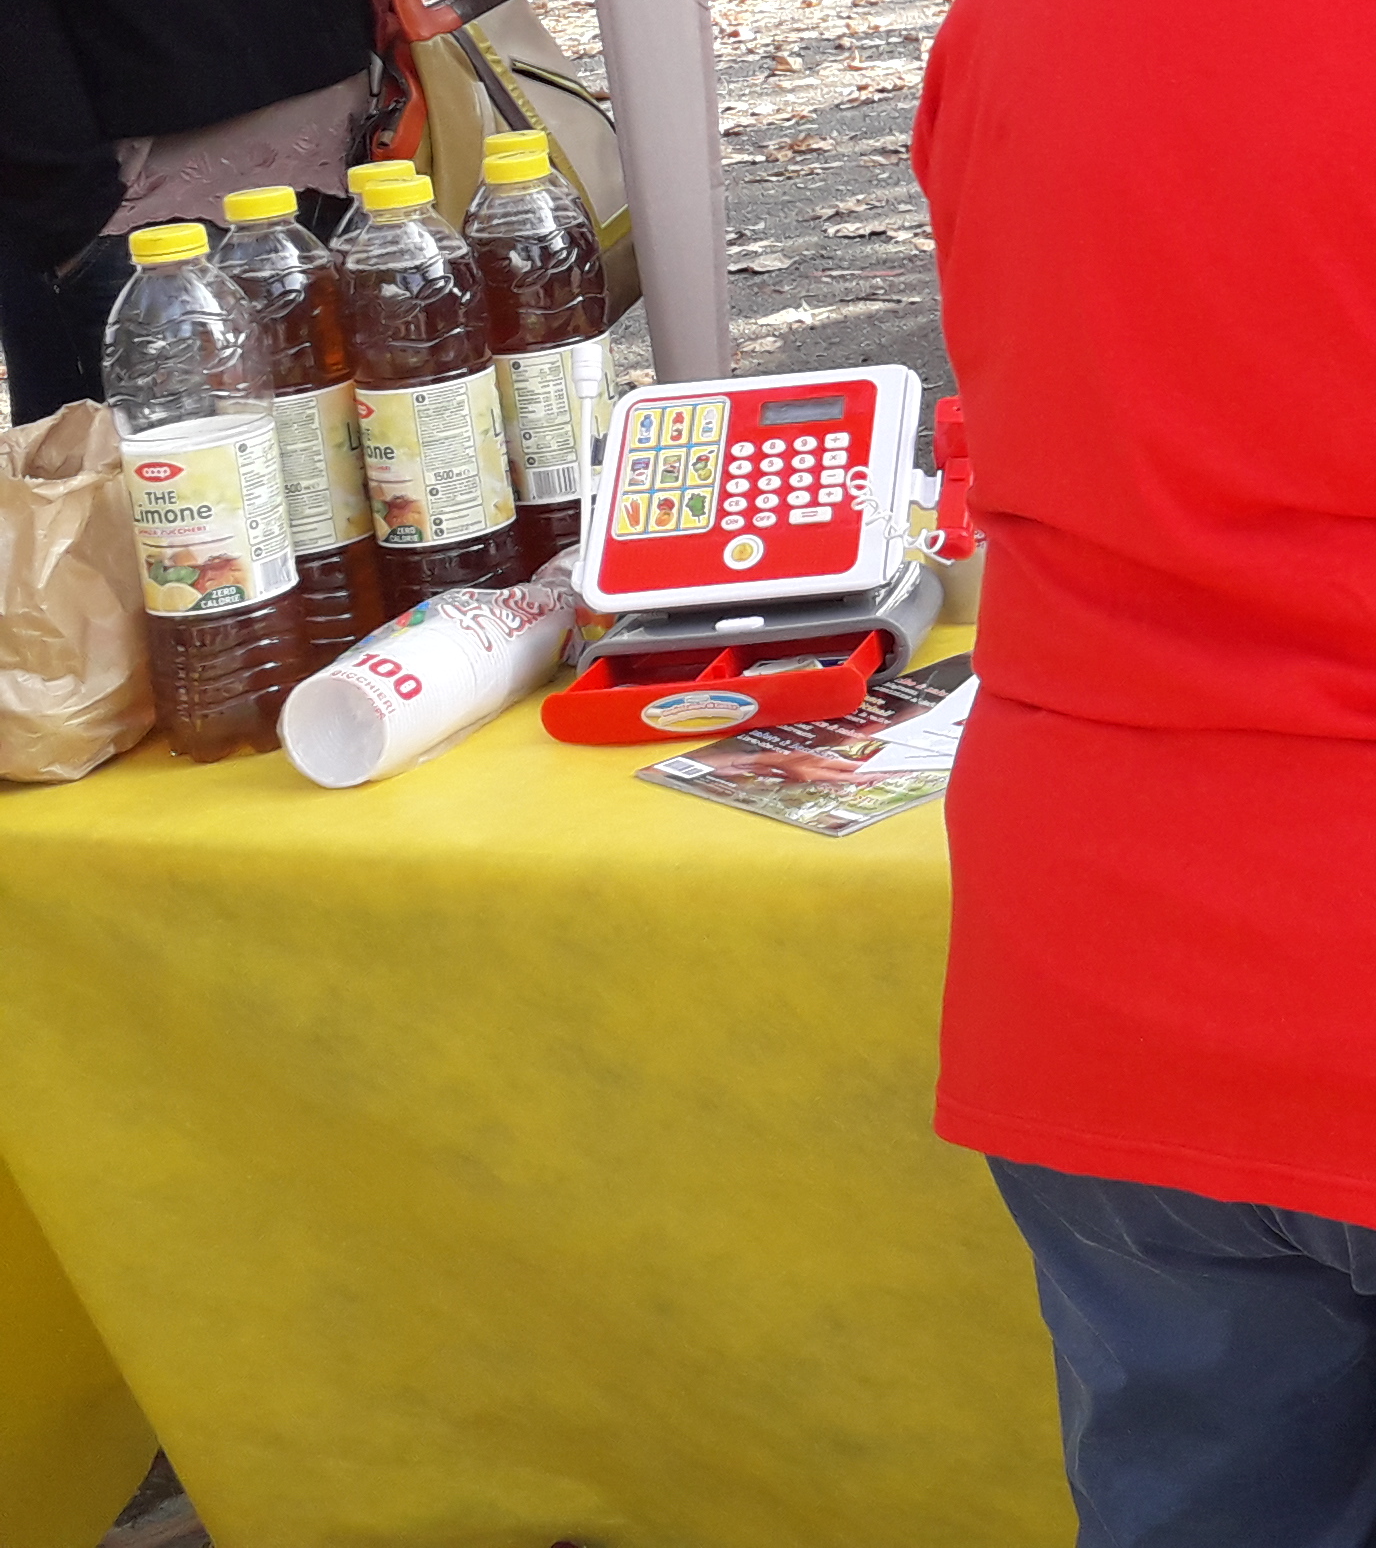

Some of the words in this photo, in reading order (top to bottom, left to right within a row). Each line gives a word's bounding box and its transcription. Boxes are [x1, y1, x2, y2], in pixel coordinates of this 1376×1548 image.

[142, 465, 171, 479] coop
[144, 490, 178, 505] THE
[211, 586, 237, 597] ZERO
[353, 652, 423, 701] 100
